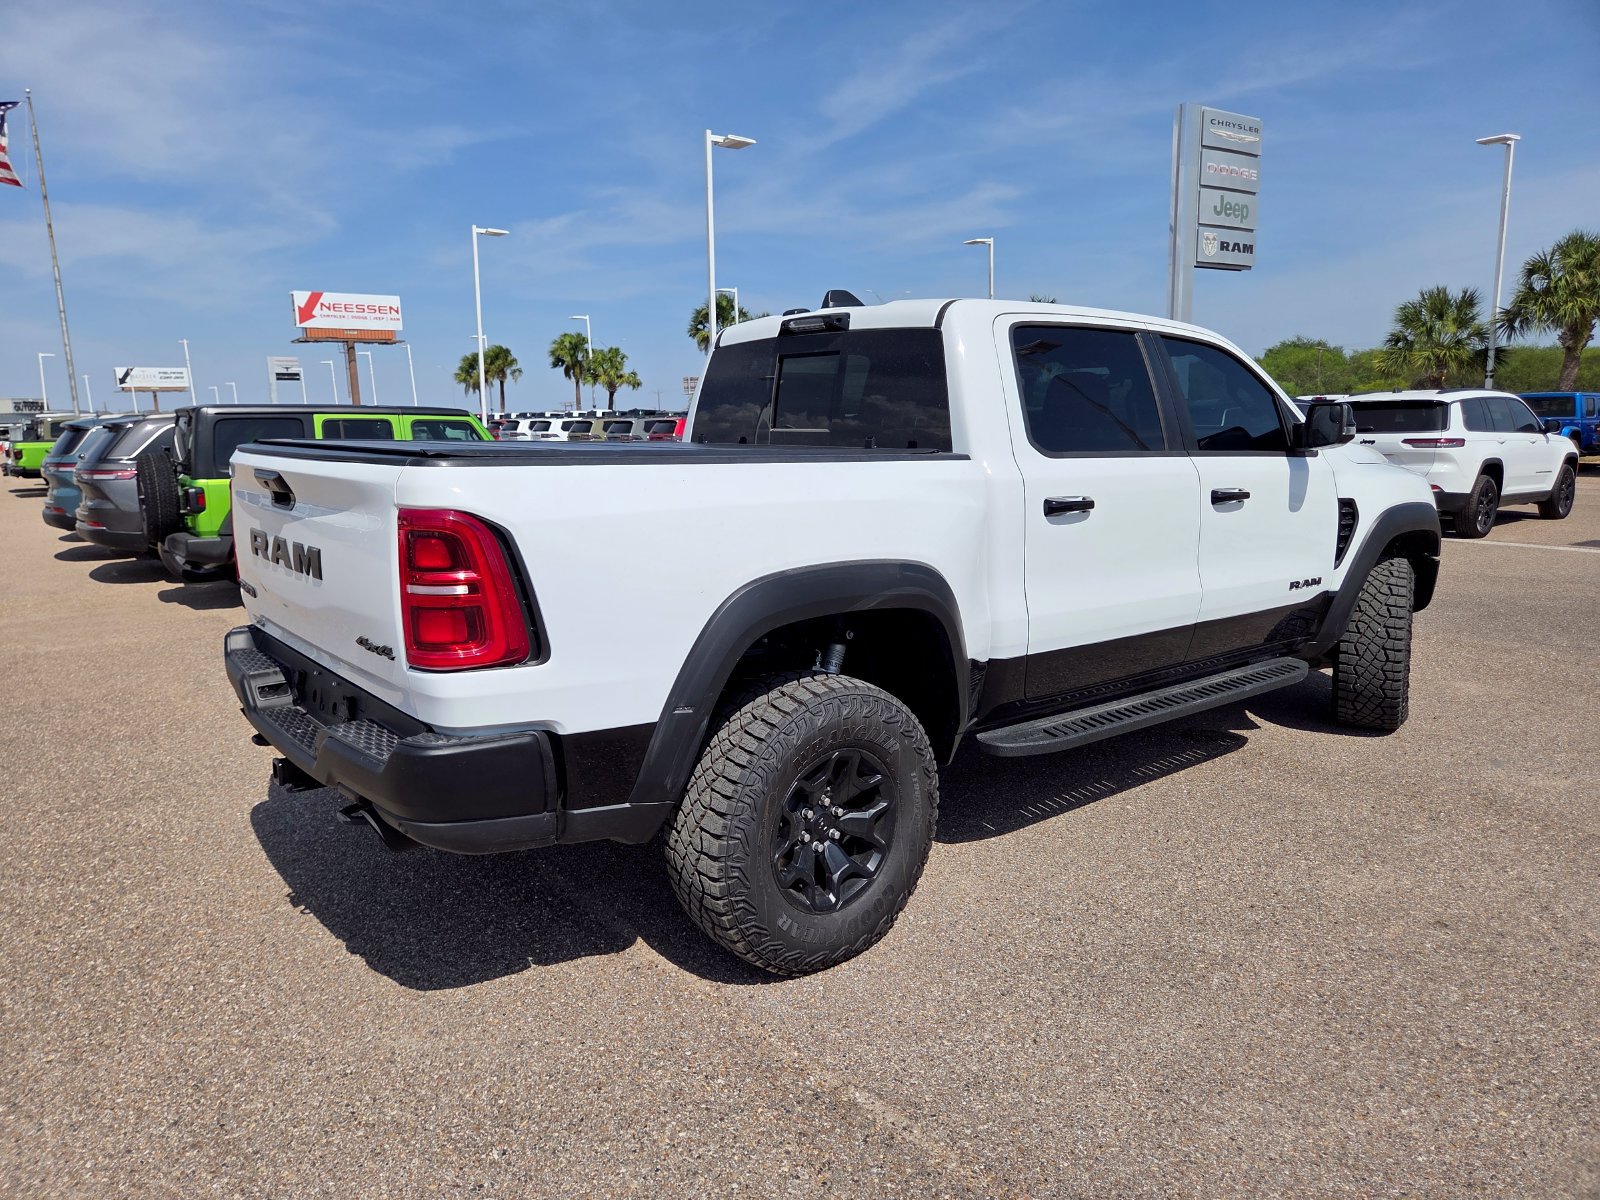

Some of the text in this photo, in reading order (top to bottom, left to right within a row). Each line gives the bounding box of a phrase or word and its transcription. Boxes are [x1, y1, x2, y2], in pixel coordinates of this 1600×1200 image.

[1210, 118, 1259, 134] CHRYSLER
[1206, 162, 1257, 180] DODGE
[1213, 194, 1249, 224] Jeep
[1219, 240, 1253, 255] RAM
[320, 302, 399, 315] NEESSEN
[250, 527, 323, 581] RAM
[1289, 576, 1322, 591] RAM
